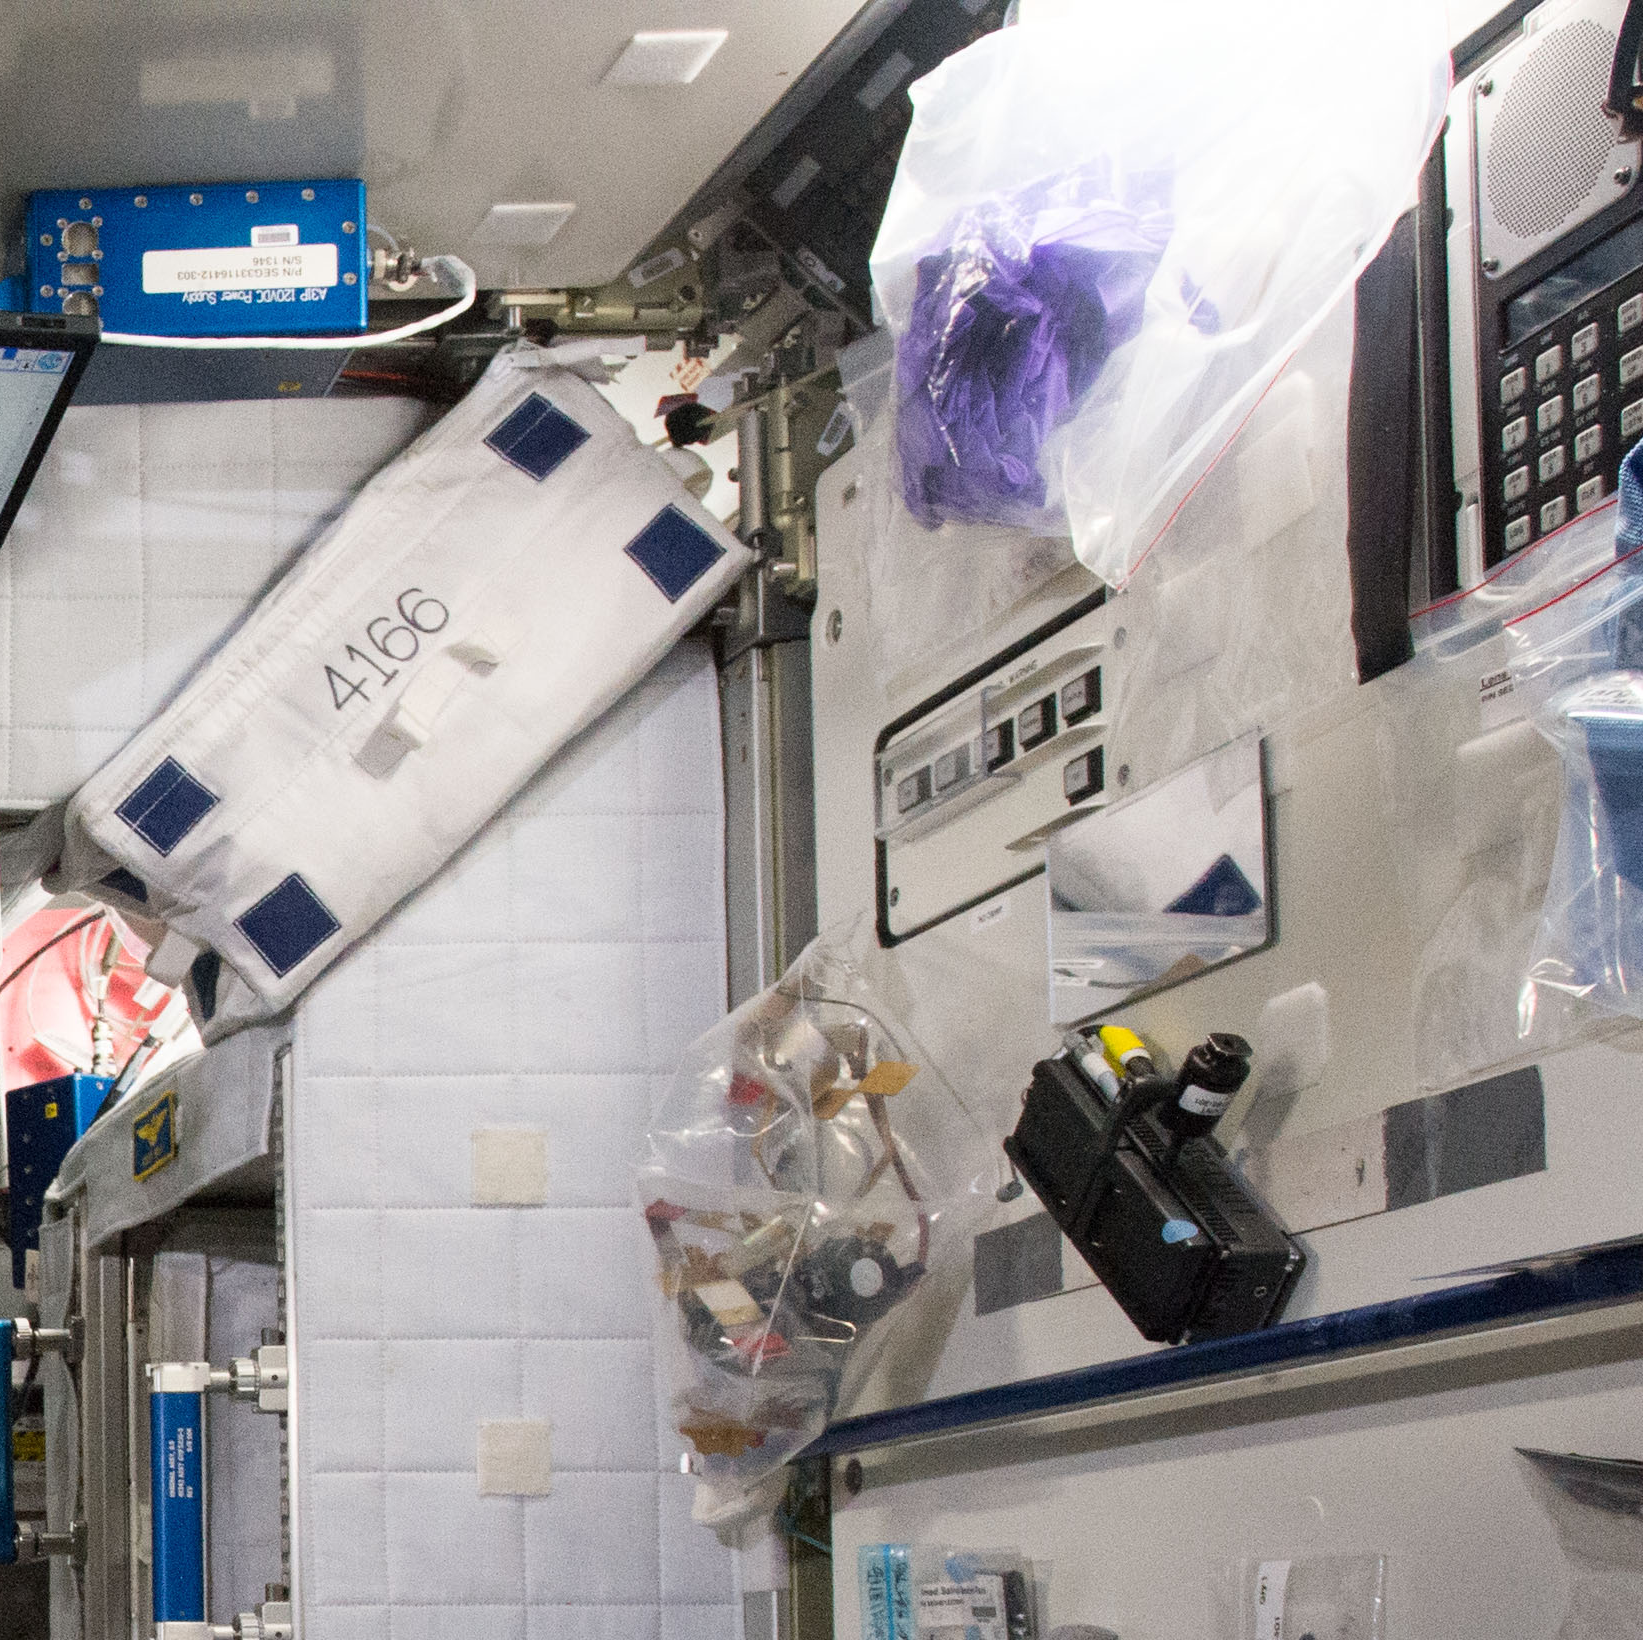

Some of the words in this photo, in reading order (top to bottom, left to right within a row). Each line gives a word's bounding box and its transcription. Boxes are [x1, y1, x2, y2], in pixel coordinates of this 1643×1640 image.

[252, 255, 278, 266] 1346
[282, 255, 303, 265] S/N
[282, 267, 303, 277] P/N
[221, 290, 253, 304] Power
[256, 288, 296, 304] 120VDC
[324, 587, 449, 711] 4166
